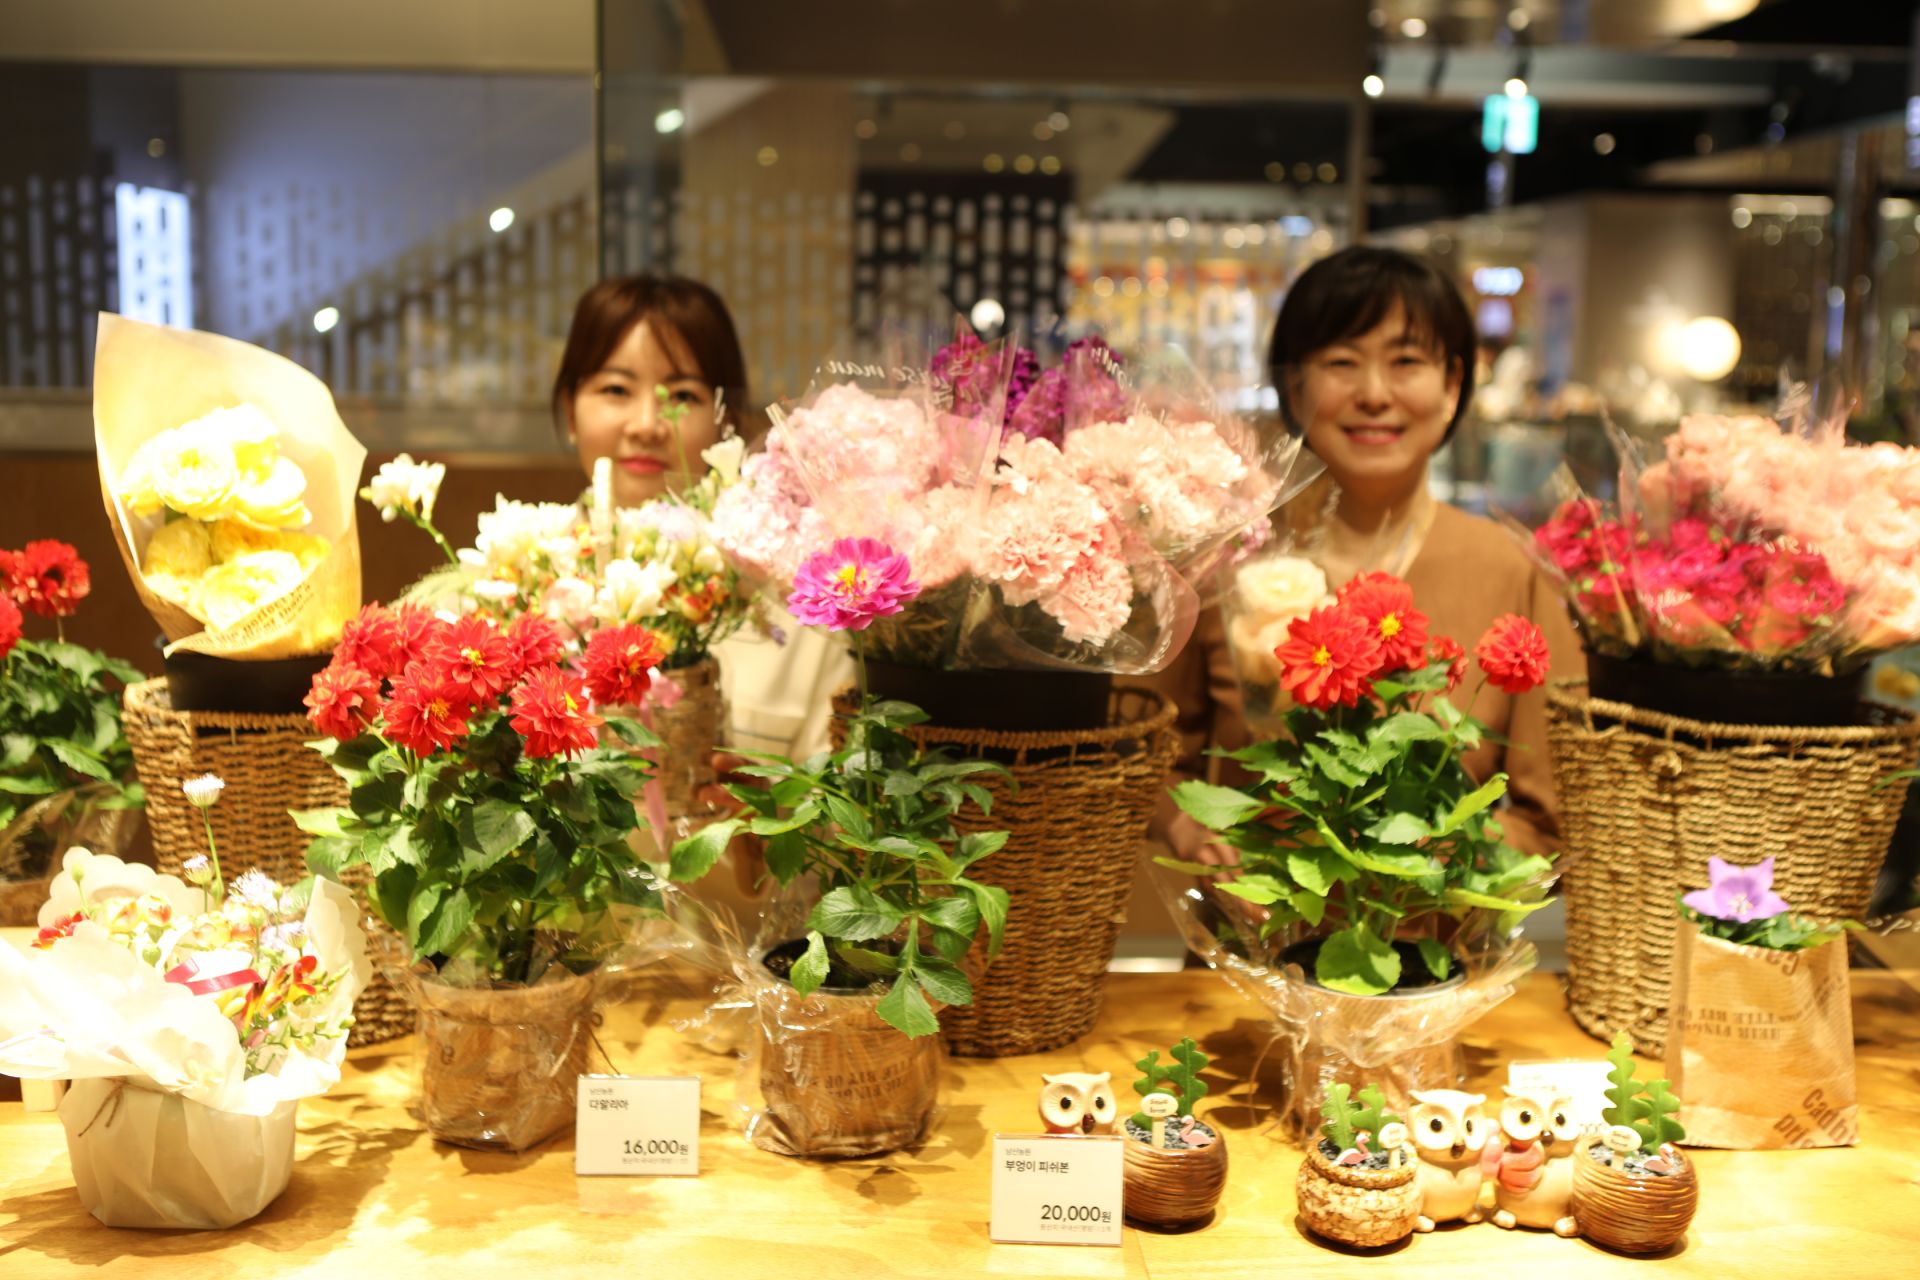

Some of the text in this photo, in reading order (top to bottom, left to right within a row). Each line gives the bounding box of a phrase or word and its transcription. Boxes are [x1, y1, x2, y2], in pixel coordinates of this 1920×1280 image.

[623, 1139, 689, 1156] 16,000원
[1004, 1160, 1070, 1174] 부엉이 피쉬본
[1040, 1204, 1112, 1223] 20,000원
